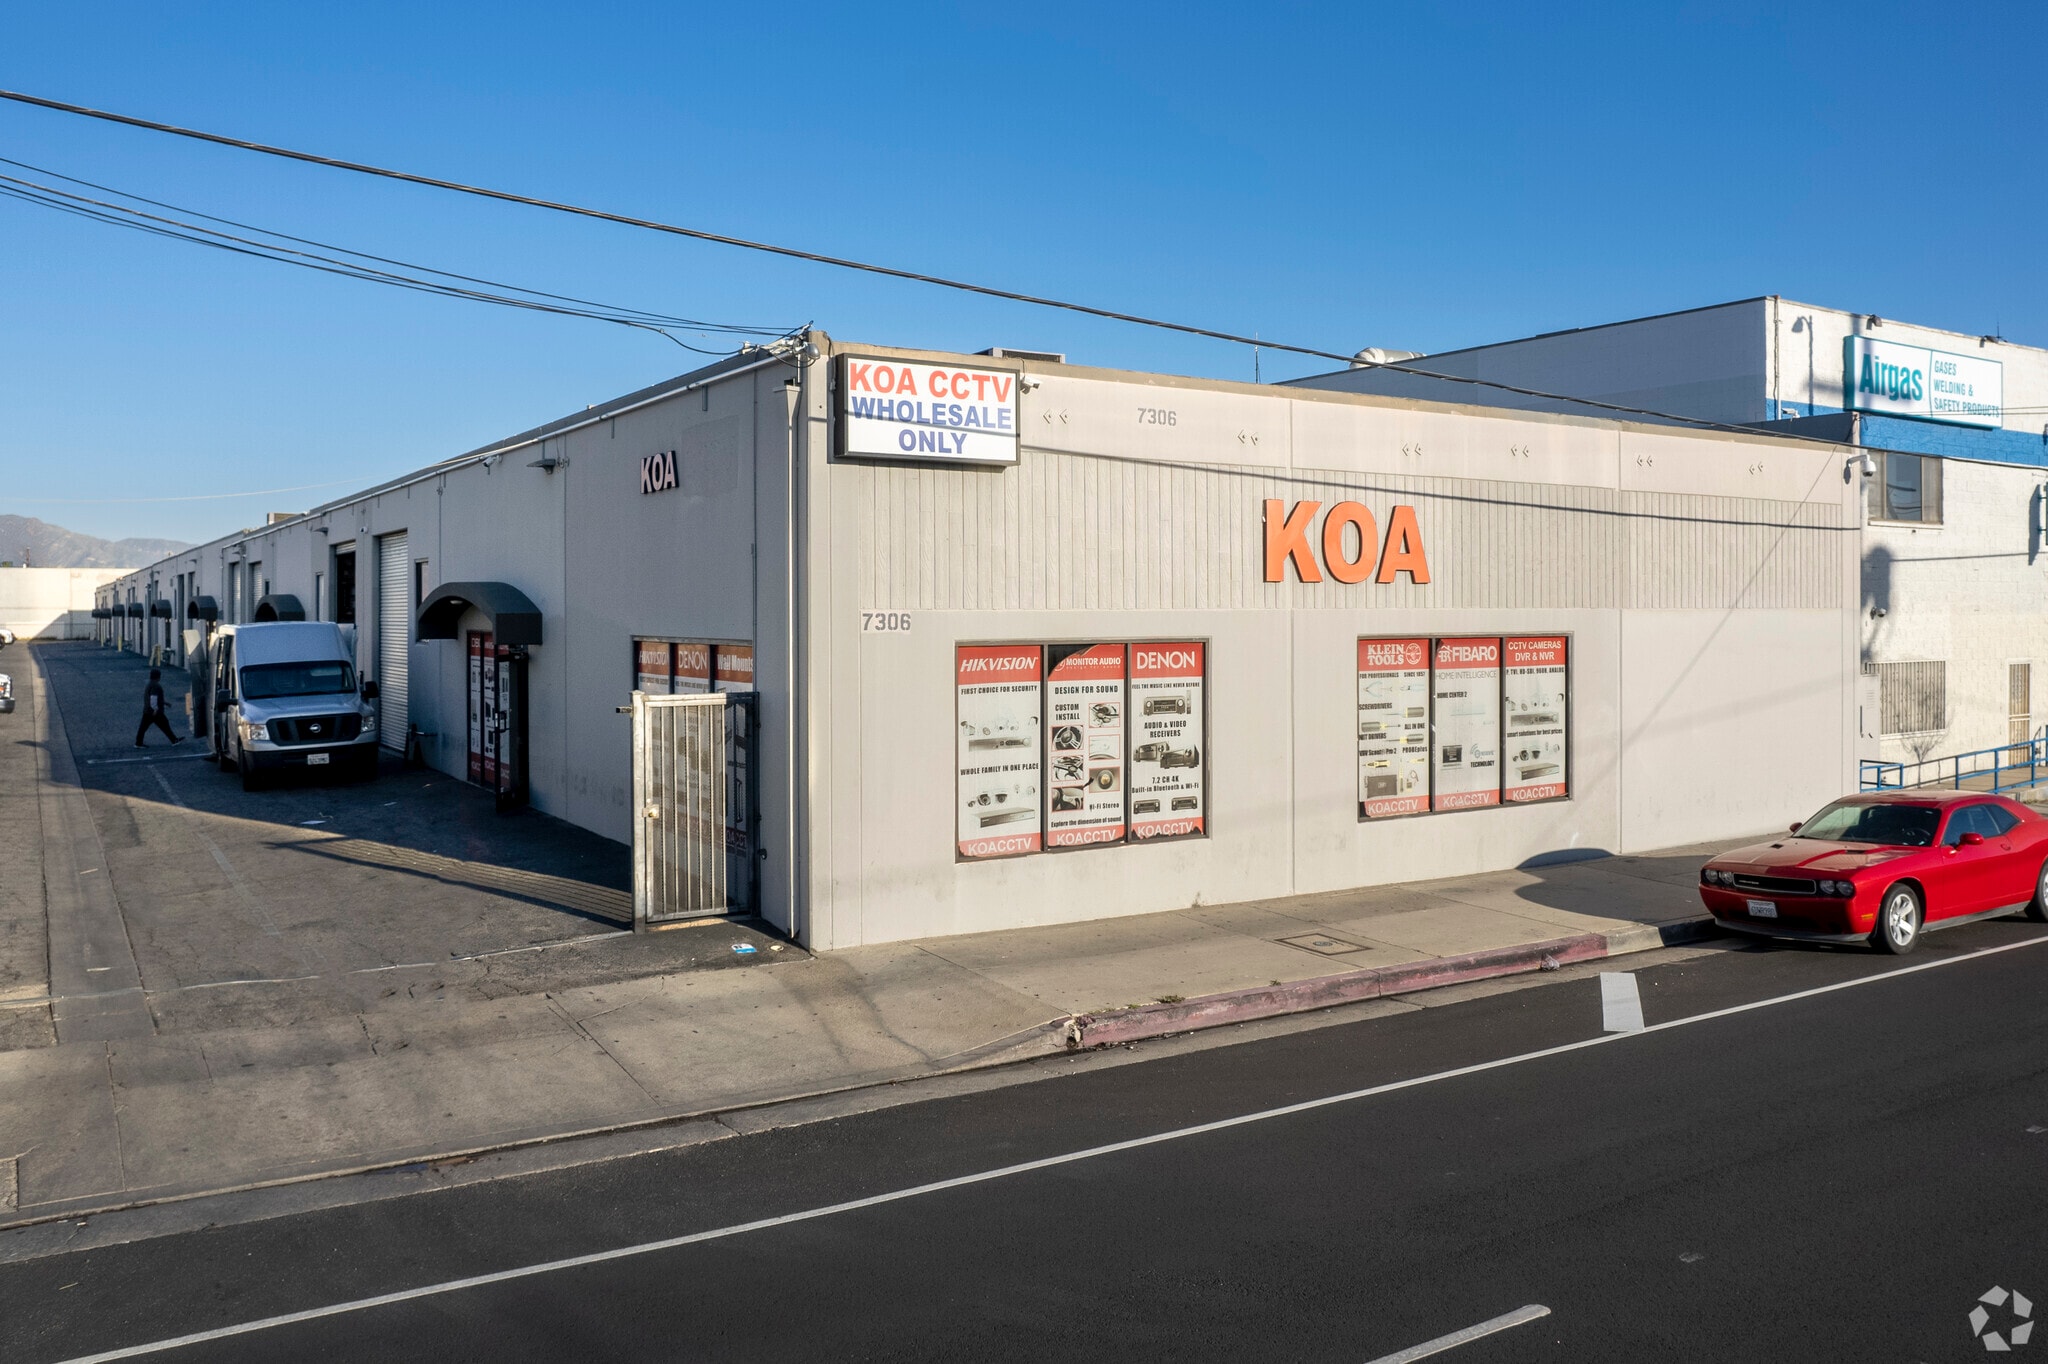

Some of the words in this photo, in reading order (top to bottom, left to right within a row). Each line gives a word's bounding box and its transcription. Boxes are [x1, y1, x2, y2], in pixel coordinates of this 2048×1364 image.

[1934, 360, 1957, 376] GASES
[850, 363, 917, 396] KOA
[929, 370, 1012, 402] CCTV
[1859, 353, 1923, 401] Airgas
[1934, 379, 1966, 395] WELDING
[1968, 384, 1974, 396] &
[851, 397, 1012, 430] WHOLESALE
[1934, 397, 1961, 413] SAFETY
[1962, 402, 2000, 419] PRODUCTS
[1137, 408, 1177, 427] 7306
[899, 430, 967, 454] ONLY
[640, 451, 679, 494] KOA
[1263, 499, 1431, 584] KOA
[862, 612, 911, 631] 7306
[1367, 643, 1404, 655] KLEIN
[1508, 641, 1527, 650] CCTV
[1528, 640, 1562, 649] CAMERAS
[678, 651, 708, 670] DENON
[717, 654, 731, 670] Wall
[1066, 657, 1099, 666] MONITOR
[1099, 656, 1121, 665] AUDIO
[1136, 651, 1195, 670] DENON
[1367, 654, 1404, 666] TOOLS
[1452, 646, 1498, 662] FIBARO
[1515, 652, 1531, 661] DVR
[1532, 652, 1538, 660] &
[1539, 651, 1555, 660] NVR
[960, 656, 1037, 672] HIKVISION
[961, 687, 977, 695] FIRST
[978, 686, 999, 694] CHOICE
[1000, 685, 1011, 693] FOR
[1054, 686, 1080, 695] DESIGN
[1081, 686, 1094, 694] FOR
[1096, 685, 1119, 694] SOUND
[1055, 703, 1080, 712] CUSTOM
[1055, 712, 1080, 721] INSTALL
[1144, 721, 1162, 729] AUDIO
[1169, 720, 1187, 728] VIDEO
[1149, 729, 1181, 738] RECEIVERS
[960, 768, 980, 776] WHOLE
[981, 766, 1002, 774] FAMILY
[1153, 784, 1179, 792] Bluetooth
[1513, 786, 1556, 800] KOACCTV
[1368, 800, 1418, 814] KOACCTV
[1443, 793, 1490, 808] KOACCTV
[1051, 820, 1069, 828] Explore
[1077, 817, 1102, 825] dimension
[1137, 821, 1193, 838] KOACCTV
[1056, 829, 1116, 845] KOACCTV
[968, 837, 1032, 856] KOACCTV
